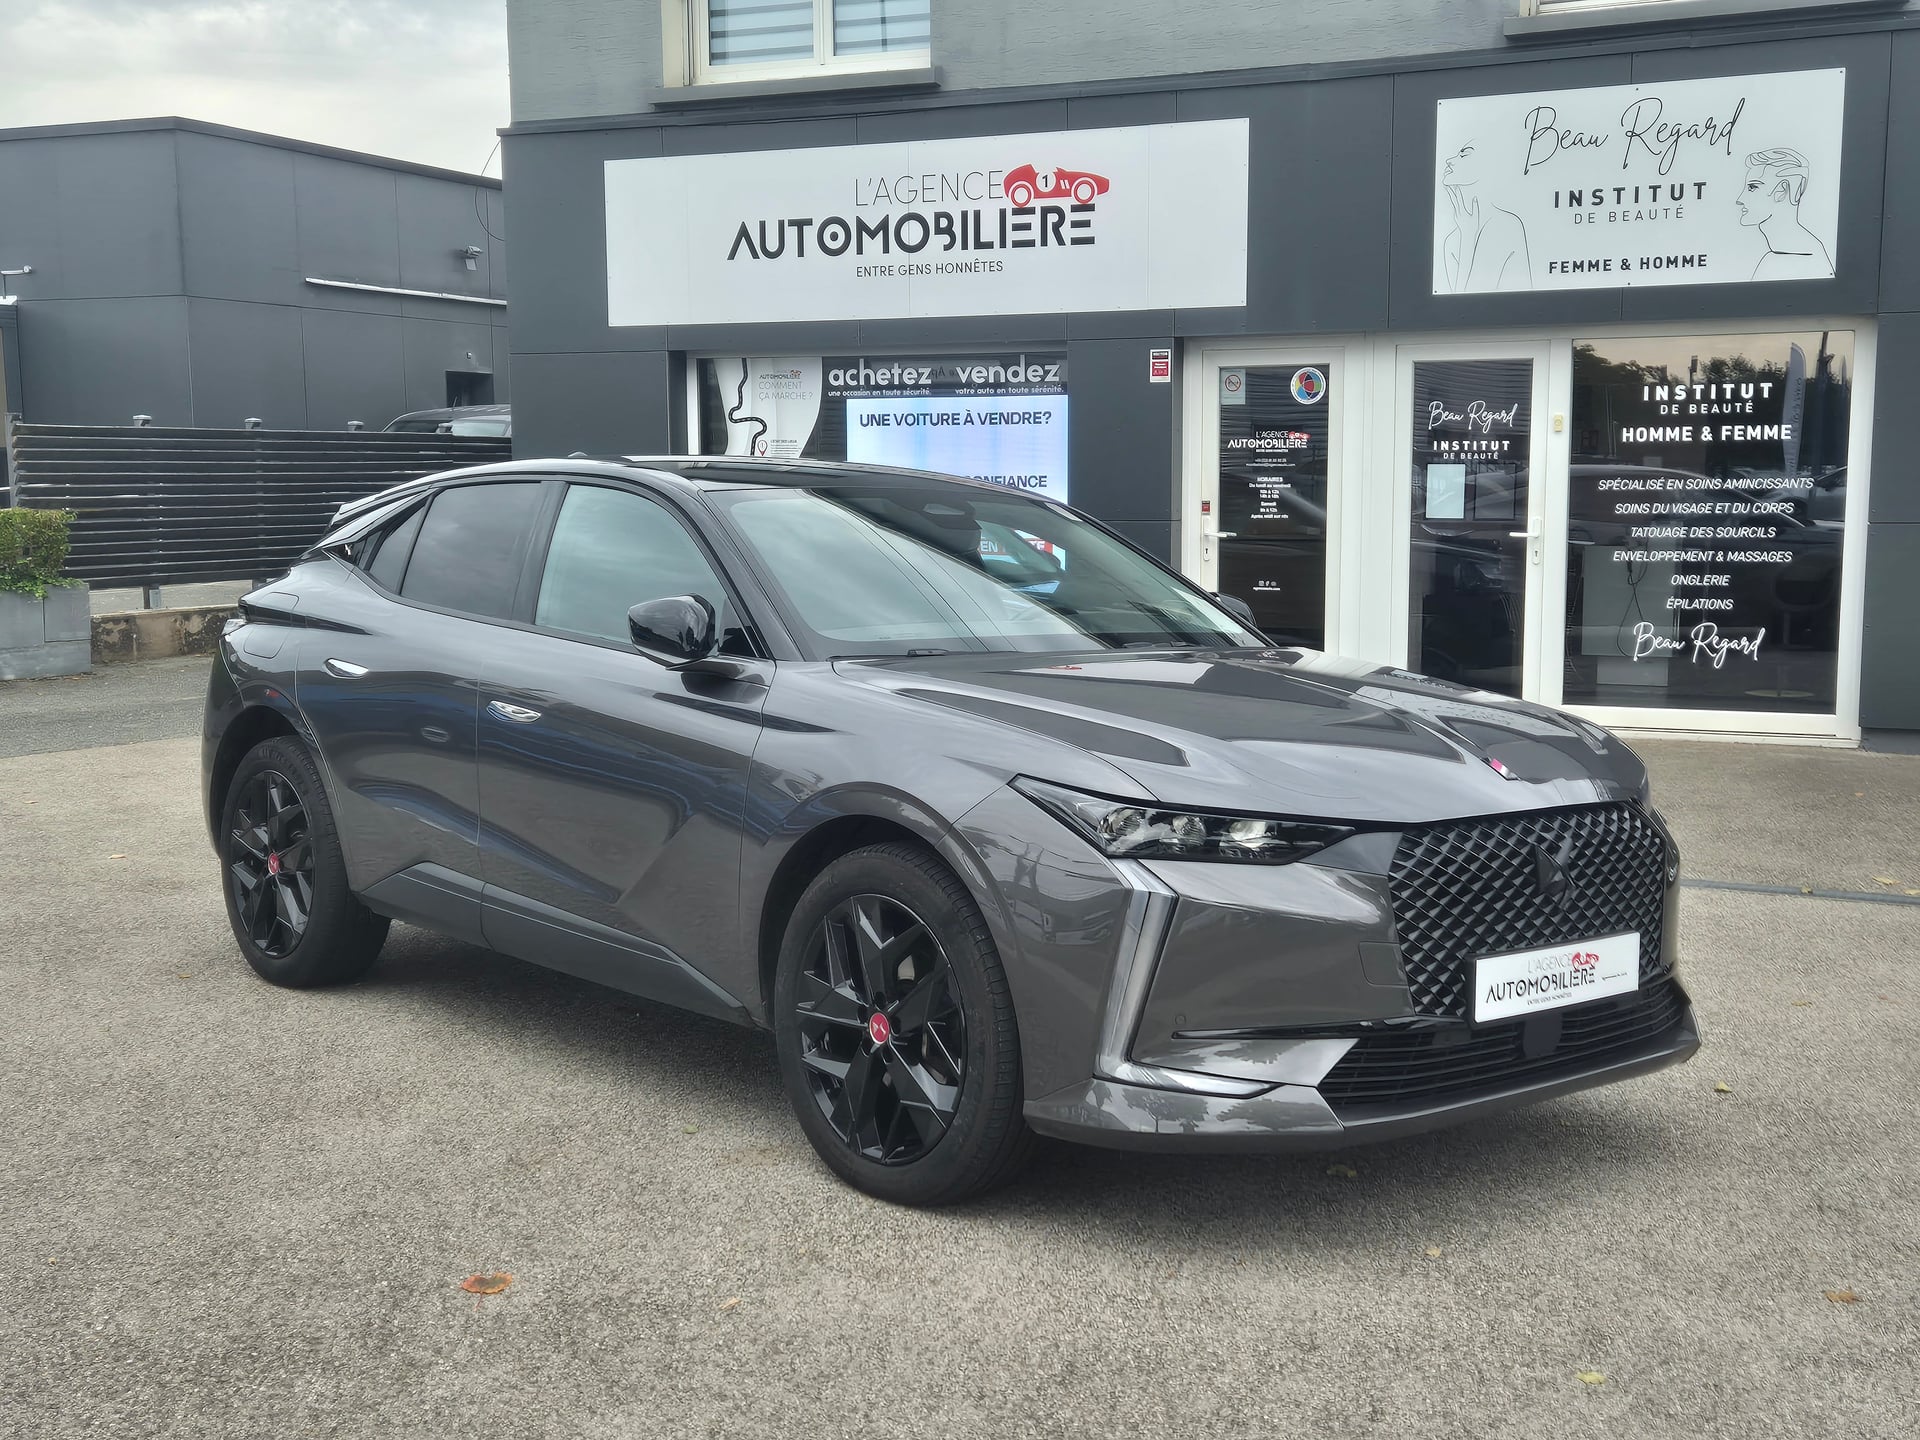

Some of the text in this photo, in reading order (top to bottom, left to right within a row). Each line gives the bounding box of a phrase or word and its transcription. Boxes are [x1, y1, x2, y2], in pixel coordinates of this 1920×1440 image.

[1524, 97, 1746, 176] Beau Regard
[854, 169, 1004, 207] L'AGENCE
[1554, 181, 1708, 209] INSTITUT
[1573, 204, 1685, 225] DE BEAUTÉ
[856, 258, 1004, 278] ENTRE GENS HONNÊTES
[1548, 254, 1708, 274] FEMME & HOMME
[828, 358, 932, 387] achetez
[955, 354, 1061, 384] vendez
[758, 381, 803, 390] COMMENT
[882, 388, 902, 396] toute
[1008, 386, 1030, 394] toute
[1643, 382, 1773, 402] INSTITUT
[758, 391, 771, 402] ÇA
[771, 391, 807, 400] MARCHE
[1660, 400, 1754, 415] DE BEAUTÉ
[859, 409, 1052, 428] UNE VOITURE À VENDRE?
[1428, 400, 1519, 434] Beau Regard
[1255, 430, 1289, 439] L'AGENCE
[1622, 424, 1793, 443] HOMME & FEMME
[1433, 440, 1511, 451] INSTITUT
[1443, 451, 1499, 460] DE BEAUTÉ
[1598, 477, 1815, 491] SPÉCIALISÉ EN SOINS AMINCISSANTS
[1615, 501, 1795, 514] SOINS DU VISAGE ET DU CORPS
[1630, 526, 1777, 538] TATOUAGE DES SOURCILS
[1612, 550, 1793, 562] ENVELOPPEMENT & MASSAGES
[1671, 574, 1732, 586] ONGLERIE
[1666, 596, 1734, 610] ÉPILATIONS
[1633, 622, 1766, 669] Beau Regard
